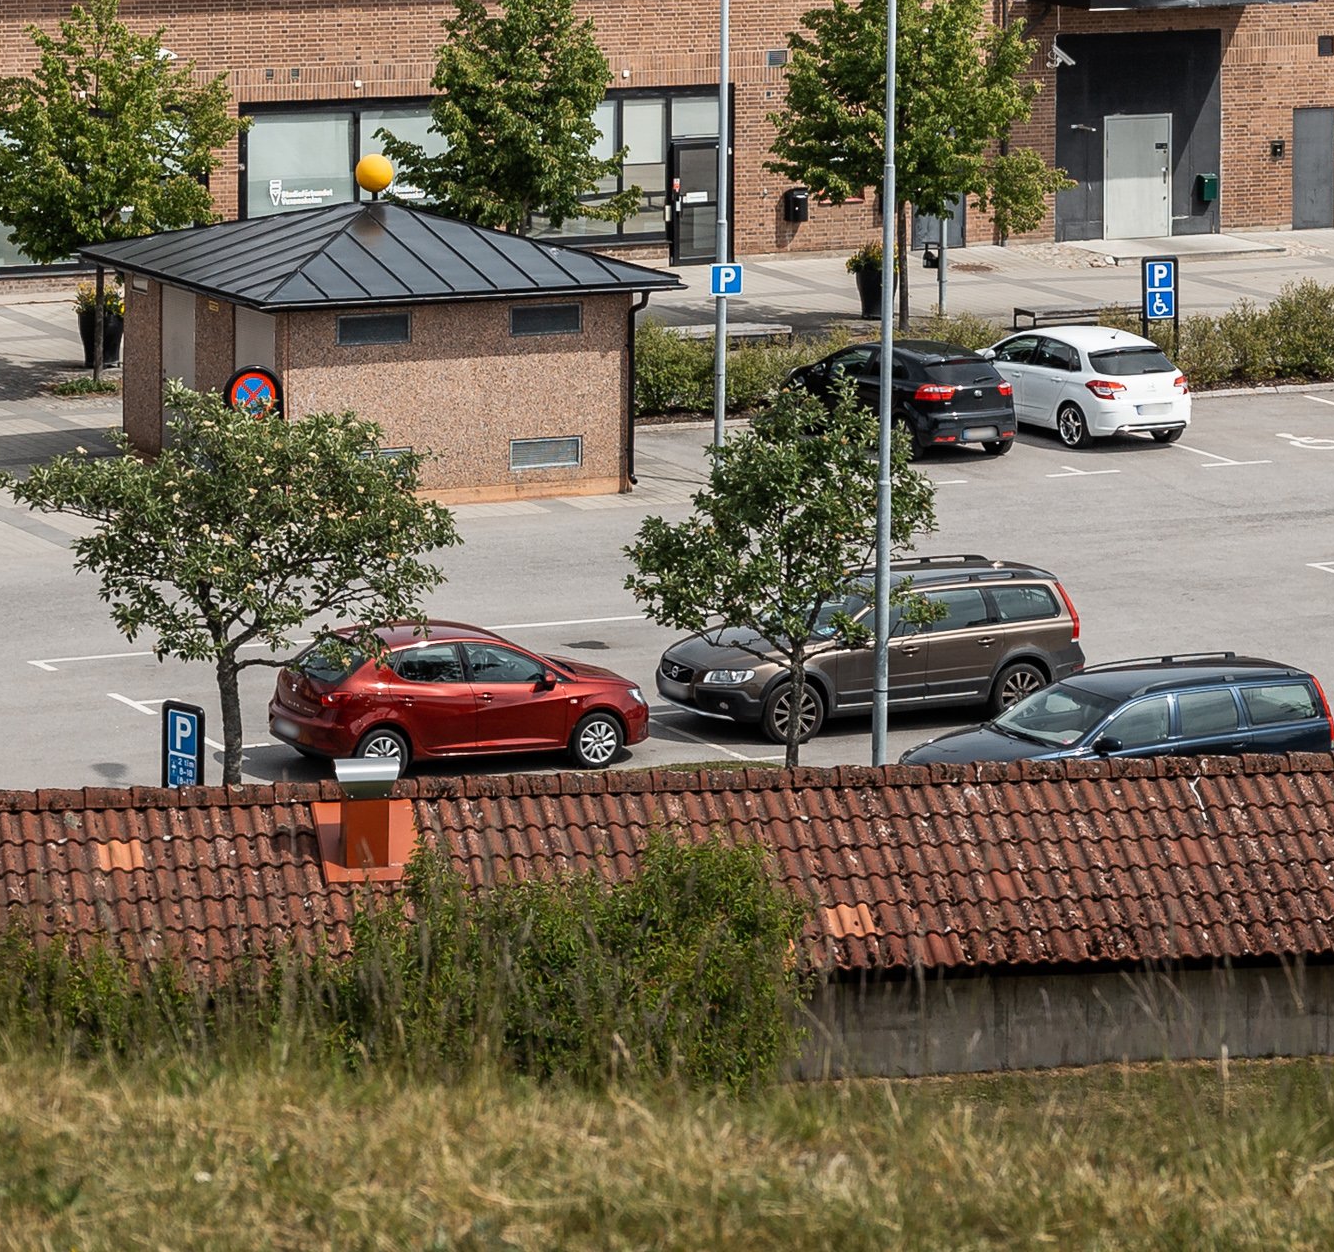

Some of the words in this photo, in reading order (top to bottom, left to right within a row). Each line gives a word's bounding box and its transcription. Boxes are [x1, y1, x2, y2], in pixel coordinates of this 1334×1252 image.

[720, 268, 736, 293] P
[1154, 264, 1168, 287] P
[176, 716, 192, 750] P
